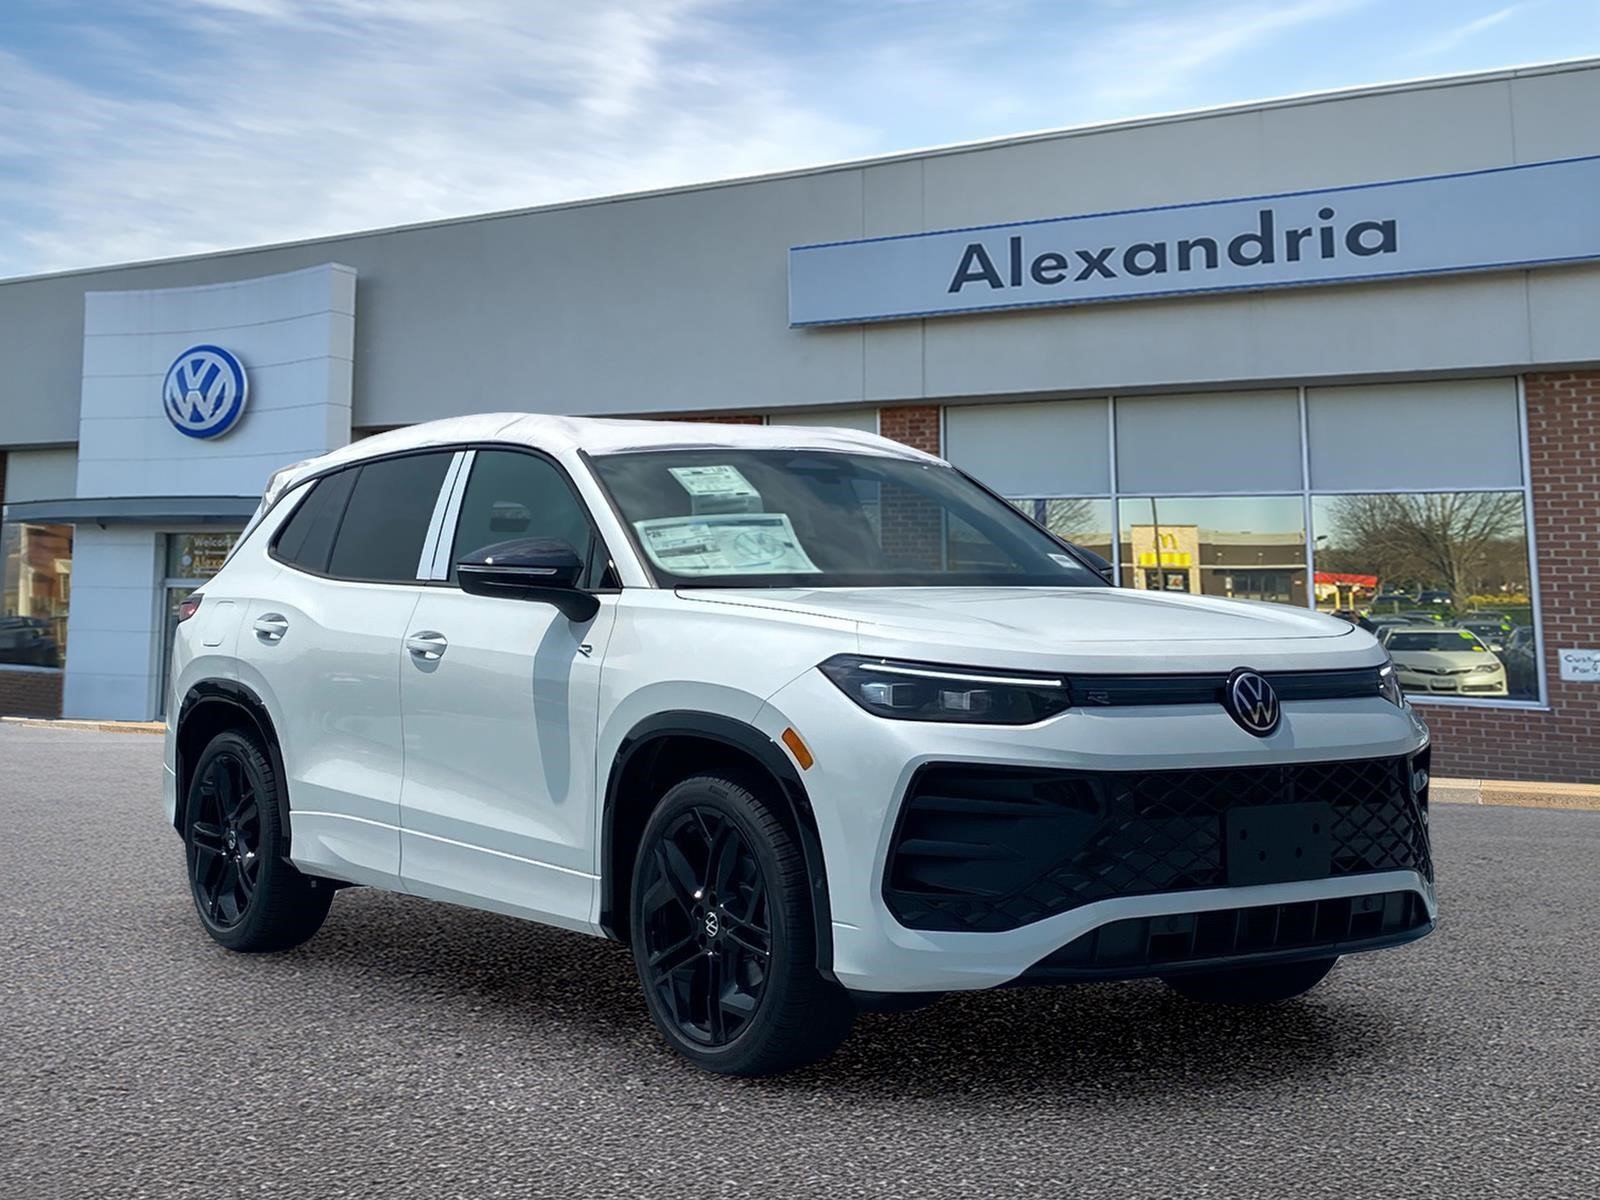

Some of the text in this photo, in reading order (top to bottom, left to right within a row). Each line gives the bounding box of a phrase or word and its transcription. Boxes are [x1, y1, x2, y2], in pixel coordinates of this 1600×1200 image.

[947, 208, 1398, 293] Alexandria
[166, 352, 237, 430] VW
[1235, 674, 1277, 729] VW
